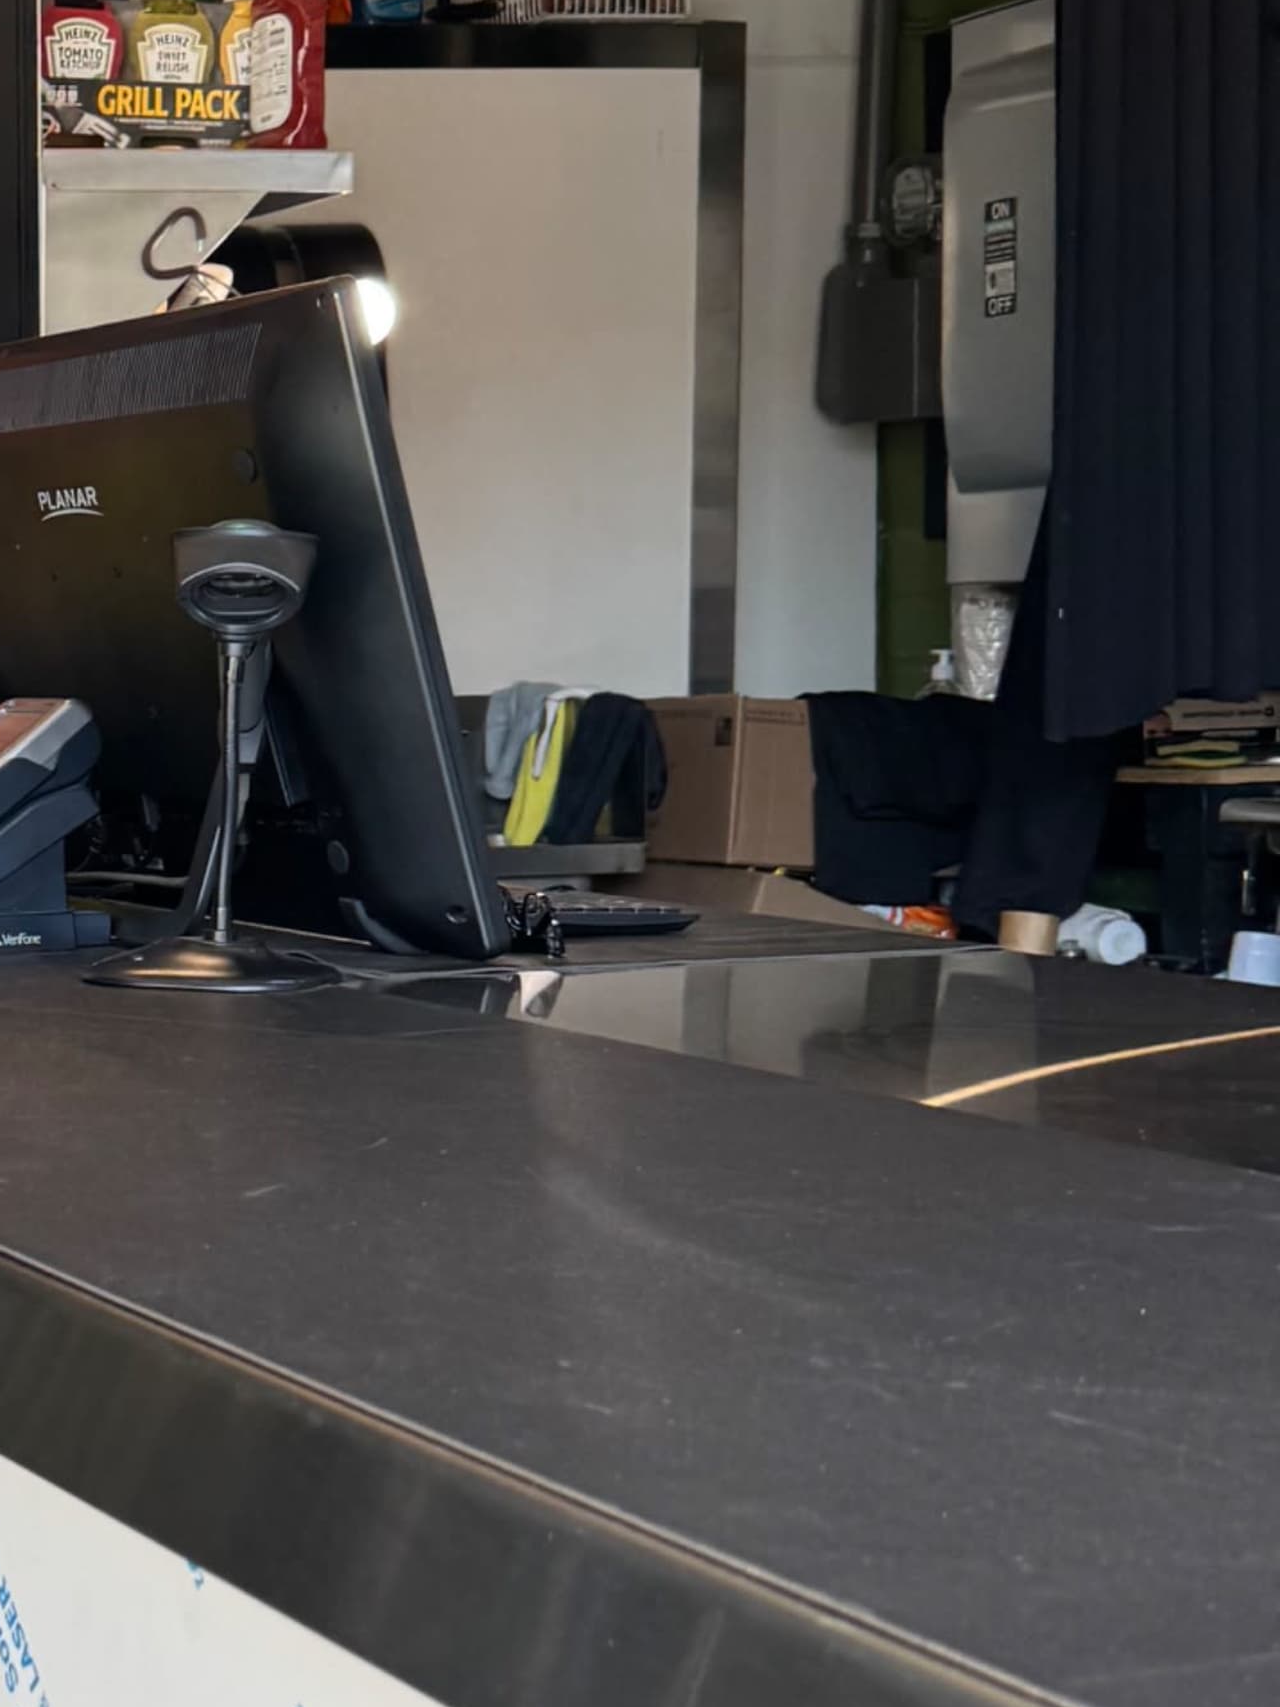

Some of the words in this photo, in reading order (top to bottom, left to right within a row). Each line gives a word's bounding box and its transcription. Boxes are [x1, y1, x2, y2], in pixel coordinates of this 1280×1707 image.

[64, 24, 98, 42] HEINZ
[156, 34, 190, 47] HEINZ
[58, 46, 103, 61] TOMATO
[156, 62, 189, 73] RELISH
[96, 84, 168, 117] GRILL
[176, 88, 241, 120] PACK
[991, 200, 1011, 220] ON
[987, 295, 1013, 316] OFF
[37, 485, 100, 511] PLANAR
